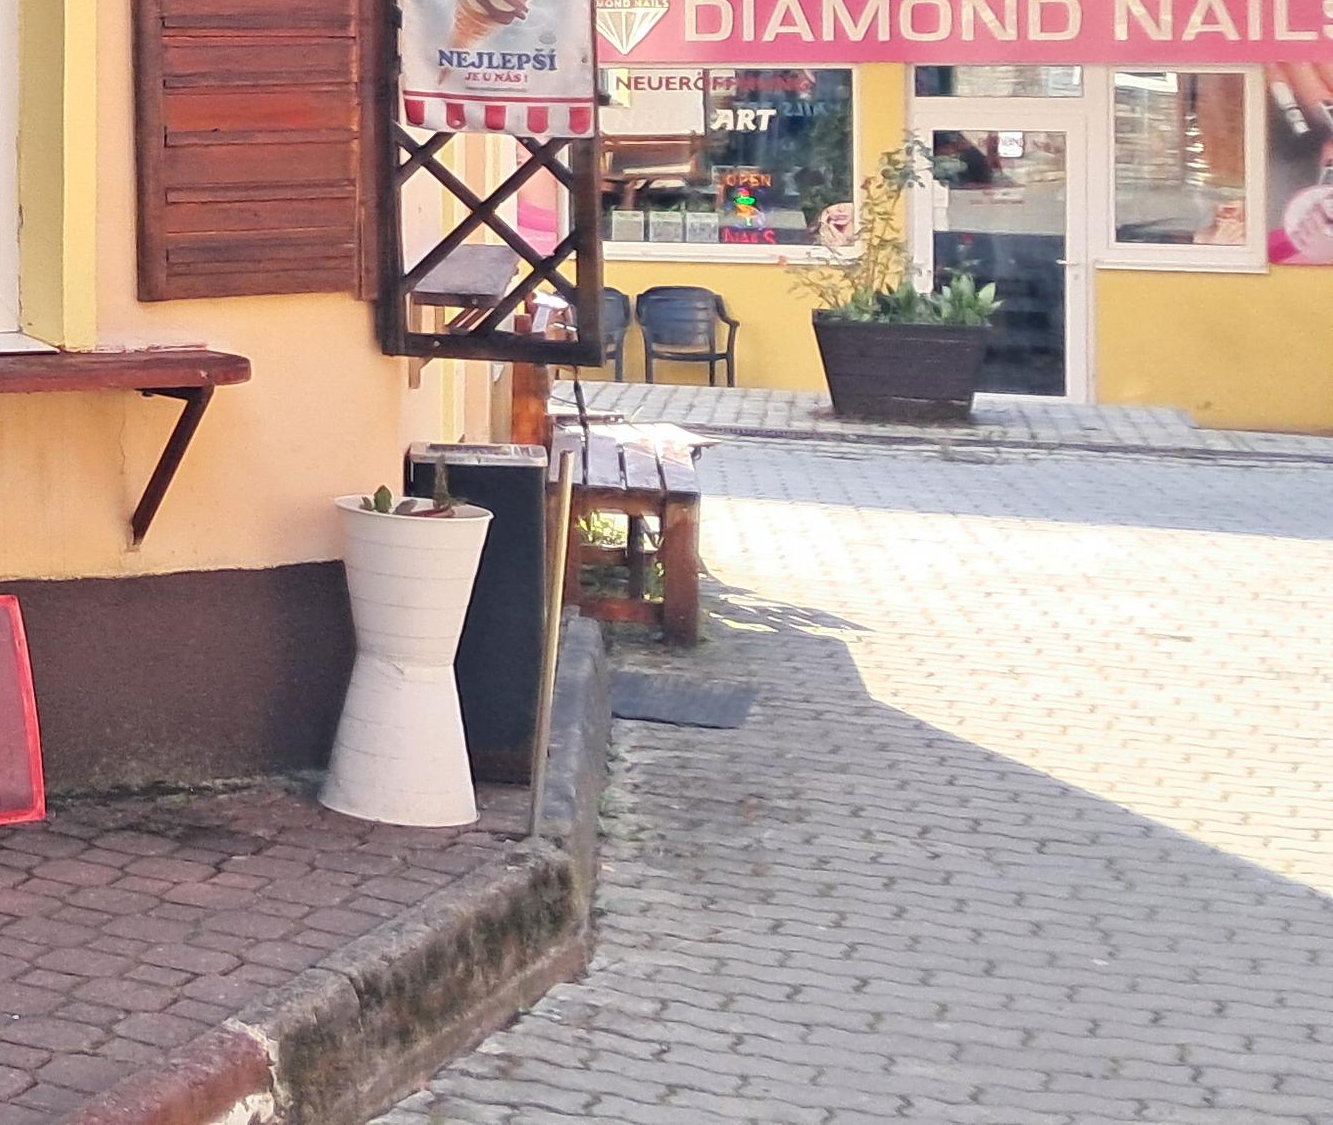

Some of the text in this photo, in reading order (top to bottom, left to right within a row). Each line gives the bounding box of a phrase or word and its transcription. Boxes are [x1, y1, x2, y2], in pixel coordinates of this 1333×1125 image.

[634, 0, 670, 8] NAILS
[437, 47, 558, 72] NEJLEPŠÍ
[710, 107, 778, 132] ART
[724, 173, 773, 188] OPEN
